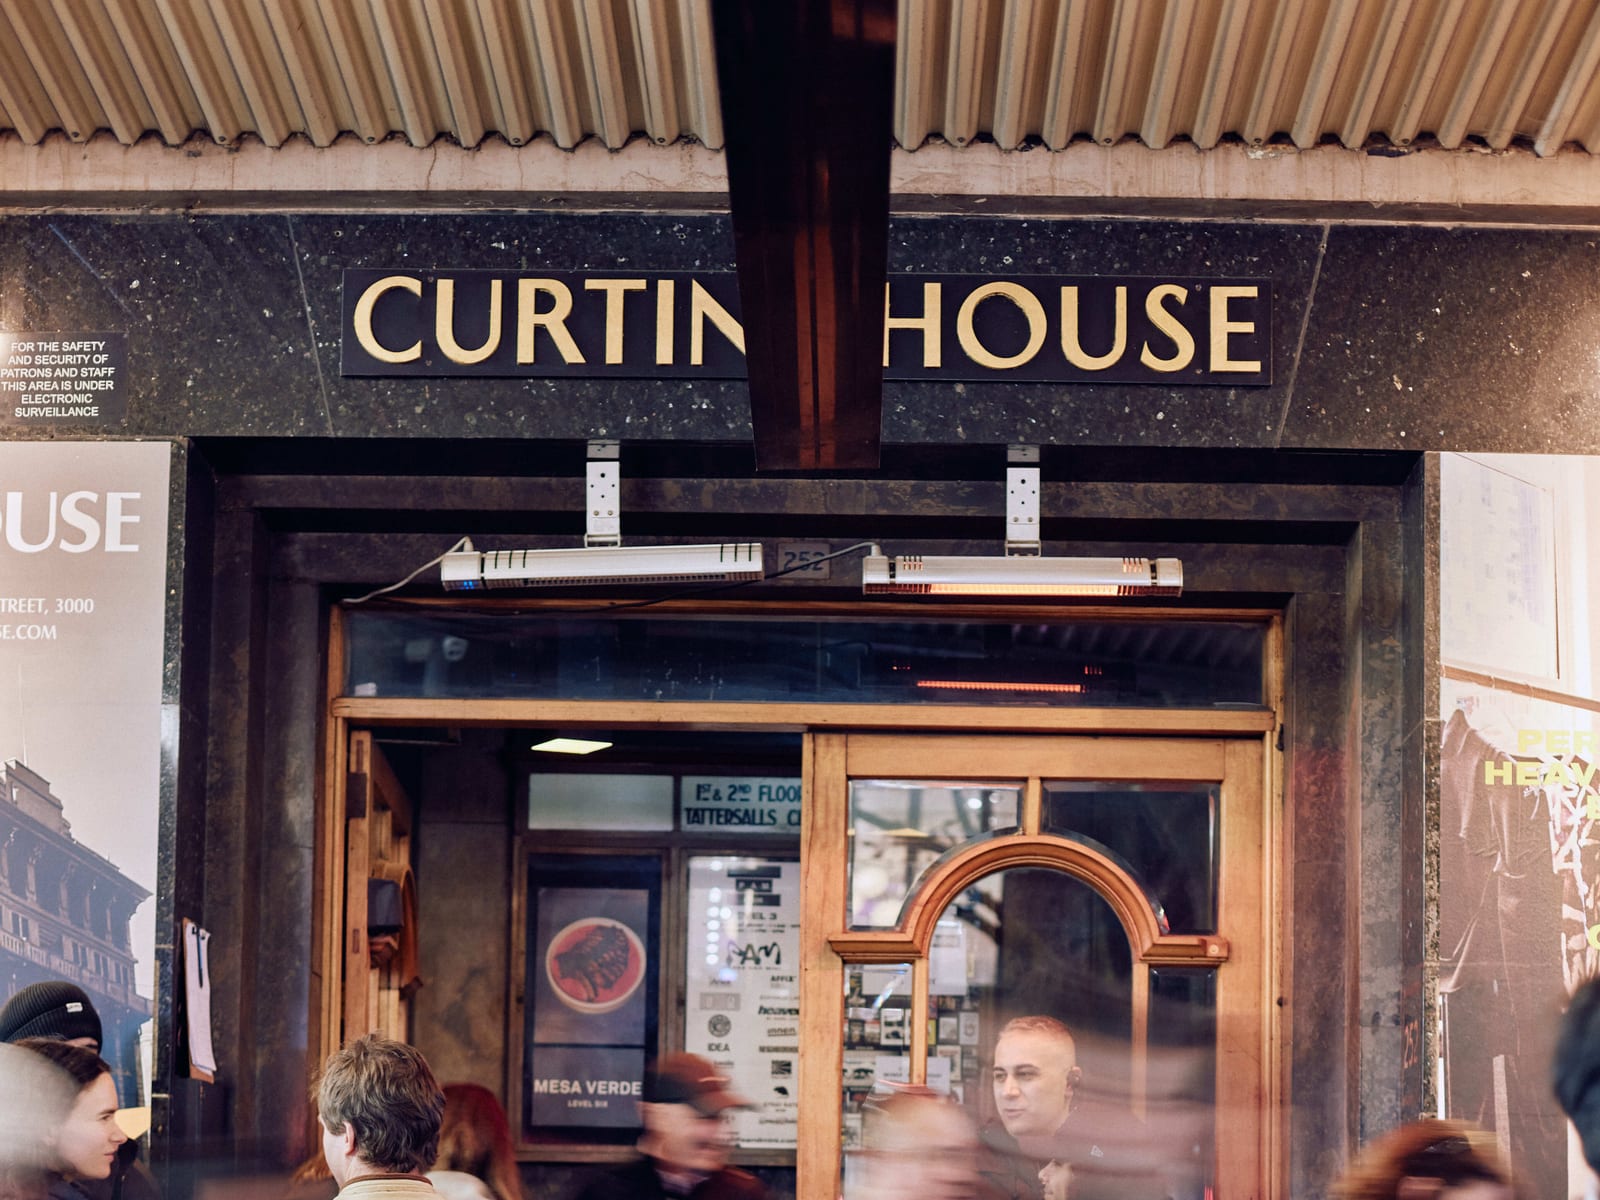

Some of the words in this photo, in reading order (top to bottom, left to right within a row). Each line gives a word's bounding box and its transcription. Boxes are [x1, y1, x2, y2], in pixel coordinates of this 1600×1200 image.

[353, 275, 746, 366] CURTIN
[882, 281, 1262, 373] HOUSE
[11, 342, 35, 352] FOR
[37, 342, 59, 352] THE
[62, 341, 105, 351] SAFETY
[8, 355, 32, 365] AND
[34, 354, 91, 365] SECURITY
[92, 354, 109, 364] OF
[0, 368, 52, 378] PATRONS
[54, 368, 78, 377] AND
[80, 367, 115, 377] STAFF
[1, 381, 27, 391] THIS
[28, 381, 59, 391] AREA
[61, 381, 72, 390] IS
[74, 380, 114, 390] UNDER
[21, 393, 93, 404] ELECTRONIC
[15, 407, 99, 417] SURVEILLANCE
[0, 490, 141, 553] USE
[783, 551, 826, 571] 252
[55, 598, 94, 613] 3000
[713, 788, 722, 801] &
[728, 784, 752, 802] 2ND
[684, 807, 777, 826] TATTERSALLS
[708, 1043, 730, 1052] IDEA
[534, 1079, 582, 1094] MESA
[586, 1080, 642, 1096] VERDE
[567, 1100, 592, 1108] LEVEL
